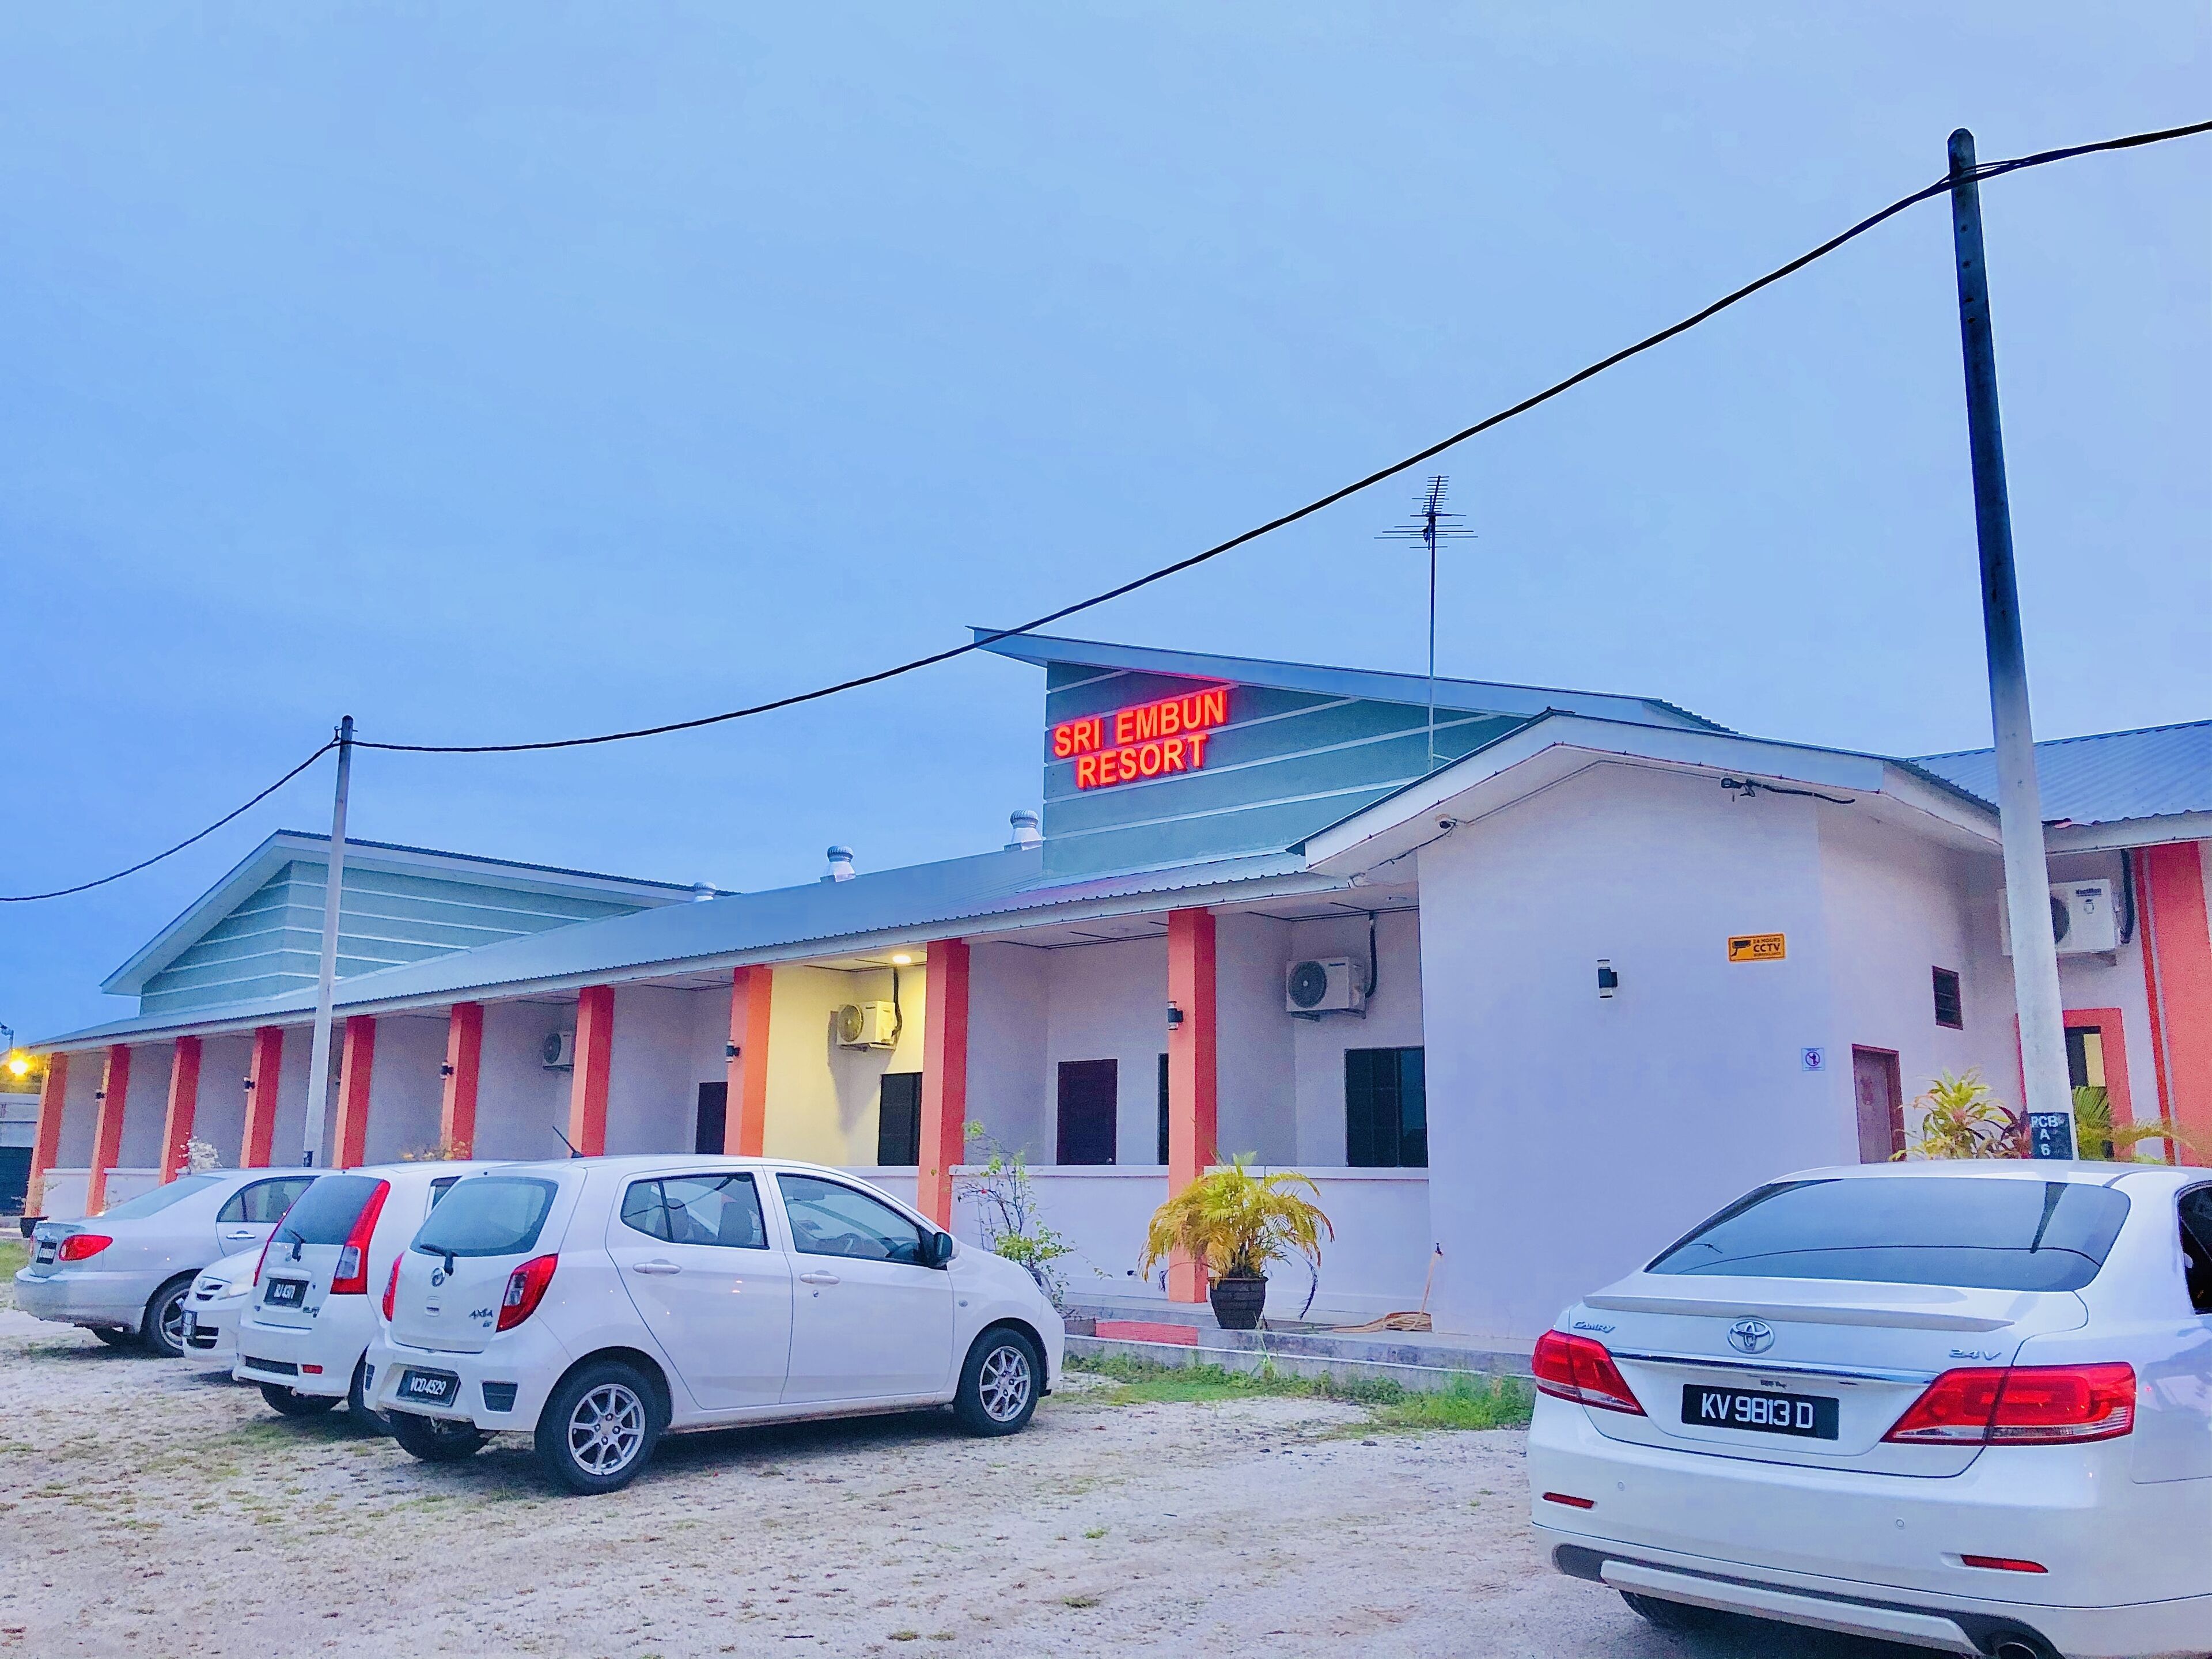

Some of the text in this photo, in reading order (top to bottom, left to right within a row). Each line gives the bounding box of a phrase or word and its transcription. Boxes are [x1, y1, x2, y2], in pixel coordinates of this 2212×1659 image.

[1054, 691, 1226, 757] SRI EMBUN
[1076, 733, 1207, 789] RESORT
[1753, 942, 1781, 953] CCTV
[2040, 1128, 2051, 1141] A
[2040, 1143, 2051, 1156] 6
[1701, 1392, 1814, 1429] KV 9813 D
